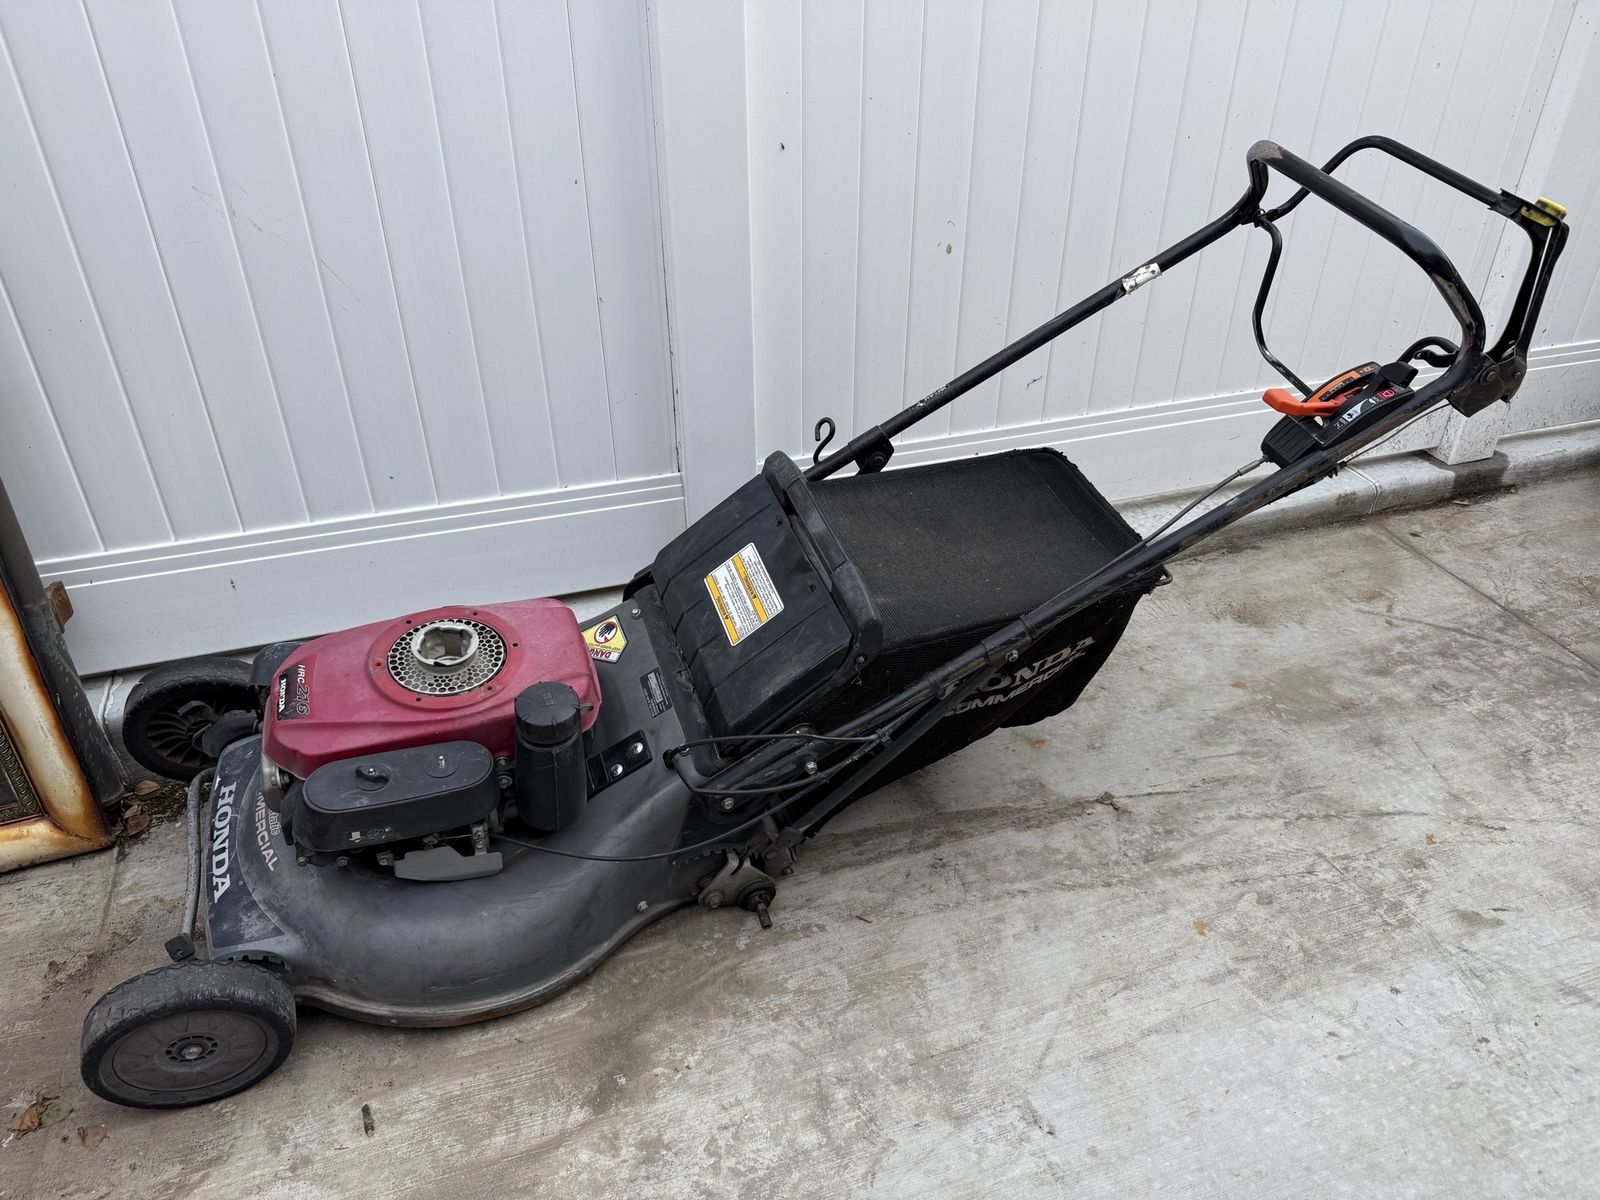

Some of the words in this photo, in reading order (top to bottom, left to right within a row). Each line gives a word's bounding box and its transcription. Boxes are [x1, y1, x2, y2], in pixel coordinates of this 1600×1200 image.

[590, 649, 611, 659] DANG
[297, 664, 306, 684] HRC
[279, 678, 287, 713] HONDA
[297, 682, 310, 715] 216
[255, 791, 278, 872] MERCIAL
[268, 808, 282, 836] static
[212, 781, 237, 904] HONDA
